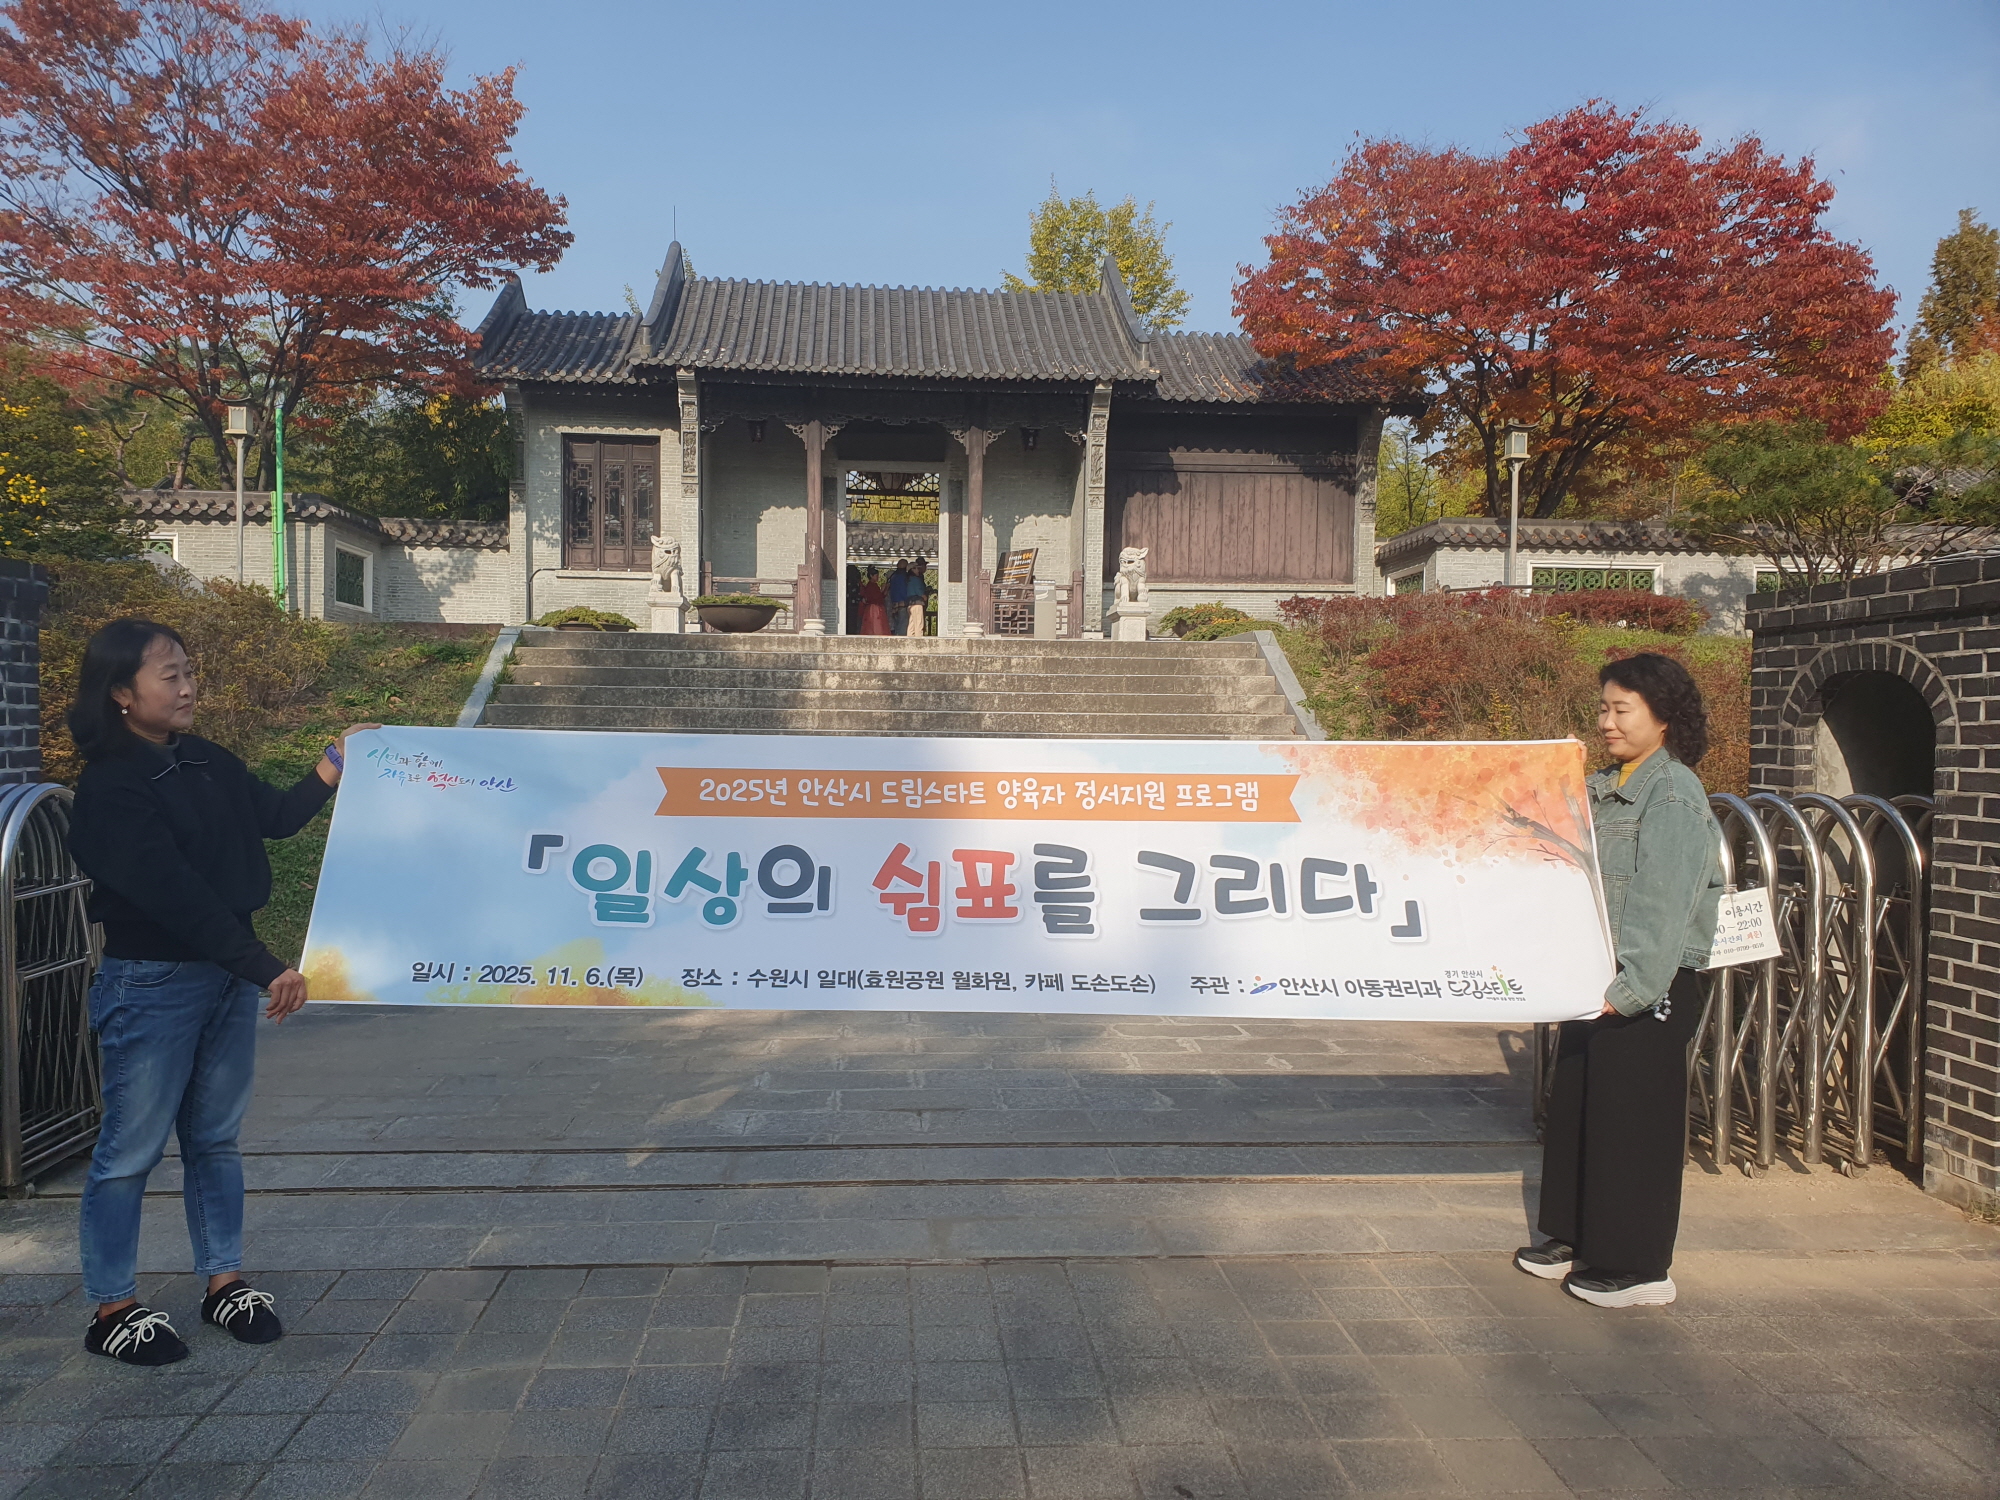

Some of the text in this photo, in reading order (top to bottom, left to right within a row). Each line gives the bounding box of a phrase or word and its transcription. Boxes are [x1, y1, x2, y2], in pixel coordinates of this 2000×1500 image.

[366, 747, 412, 768] 시민과
[378, 768, 519, 793] 자유로운 혁신도시 안산
[699, 777, 1260, 812] 2025년 안산시 드림스타트 양육자 정서지원 프로그램
[871, 842, 1095, 935] 쉼표를
[1725, 901, 1763, 918] 이용시간
[1737, 917, 1762, 931] 22:00
[411, 961, 645, 988] 일시 : 2025. 11. 6.(목)
[681, 967, 1157, 995] 장소 : 수원시 일대(효원공원 월화원, 카페 도손도손)
[1444, 970, 1483, 979] 경기 안산시
[1190, 976, 1442, 999] 주관 : 안산시 아동권리과
[1447, 976, 1524, 1000] 드림스타트
